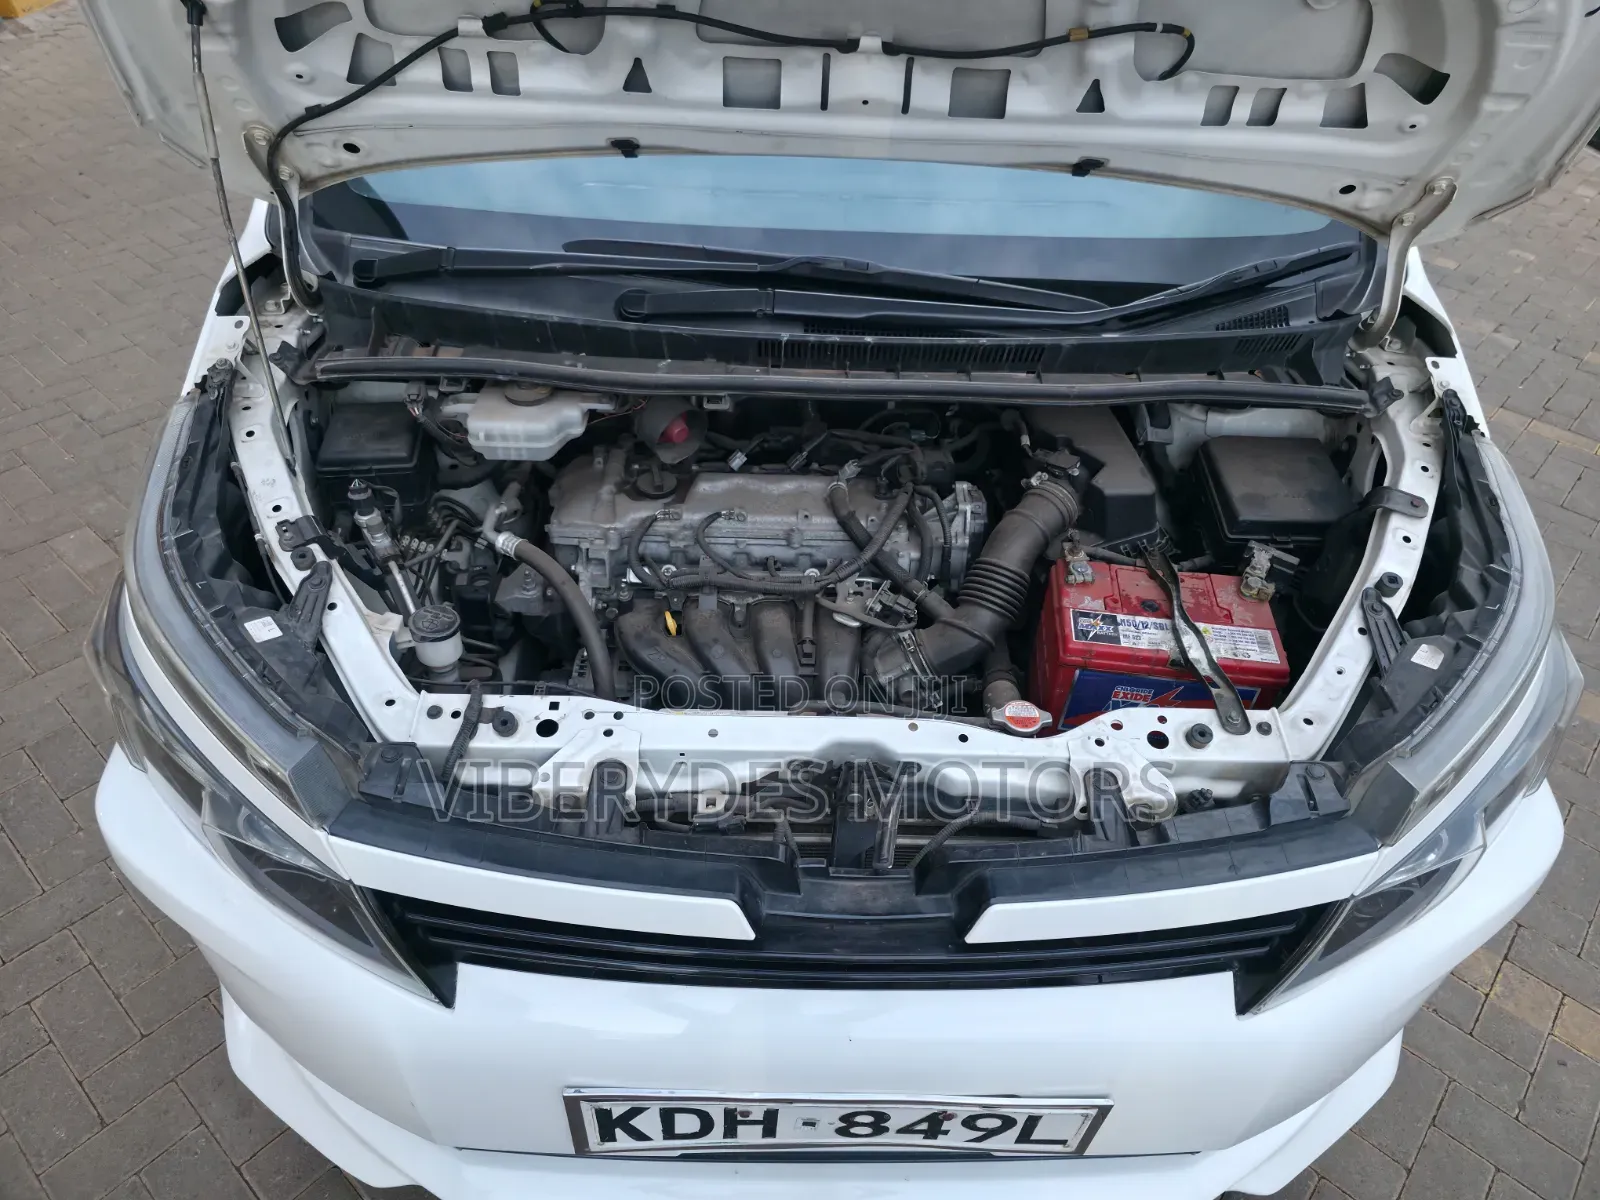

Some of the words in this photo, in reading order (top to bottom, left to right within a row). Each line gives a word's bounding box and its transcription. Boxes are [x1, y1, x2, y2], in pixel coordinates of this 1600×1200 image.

[1112, 690, 1153, 703] EXIDE
[1115, 685, 1154, 695] CHLORIDE
[595, 1106, 780, 1143] KDH
[834, 1110, 1069, 1145] 849L
